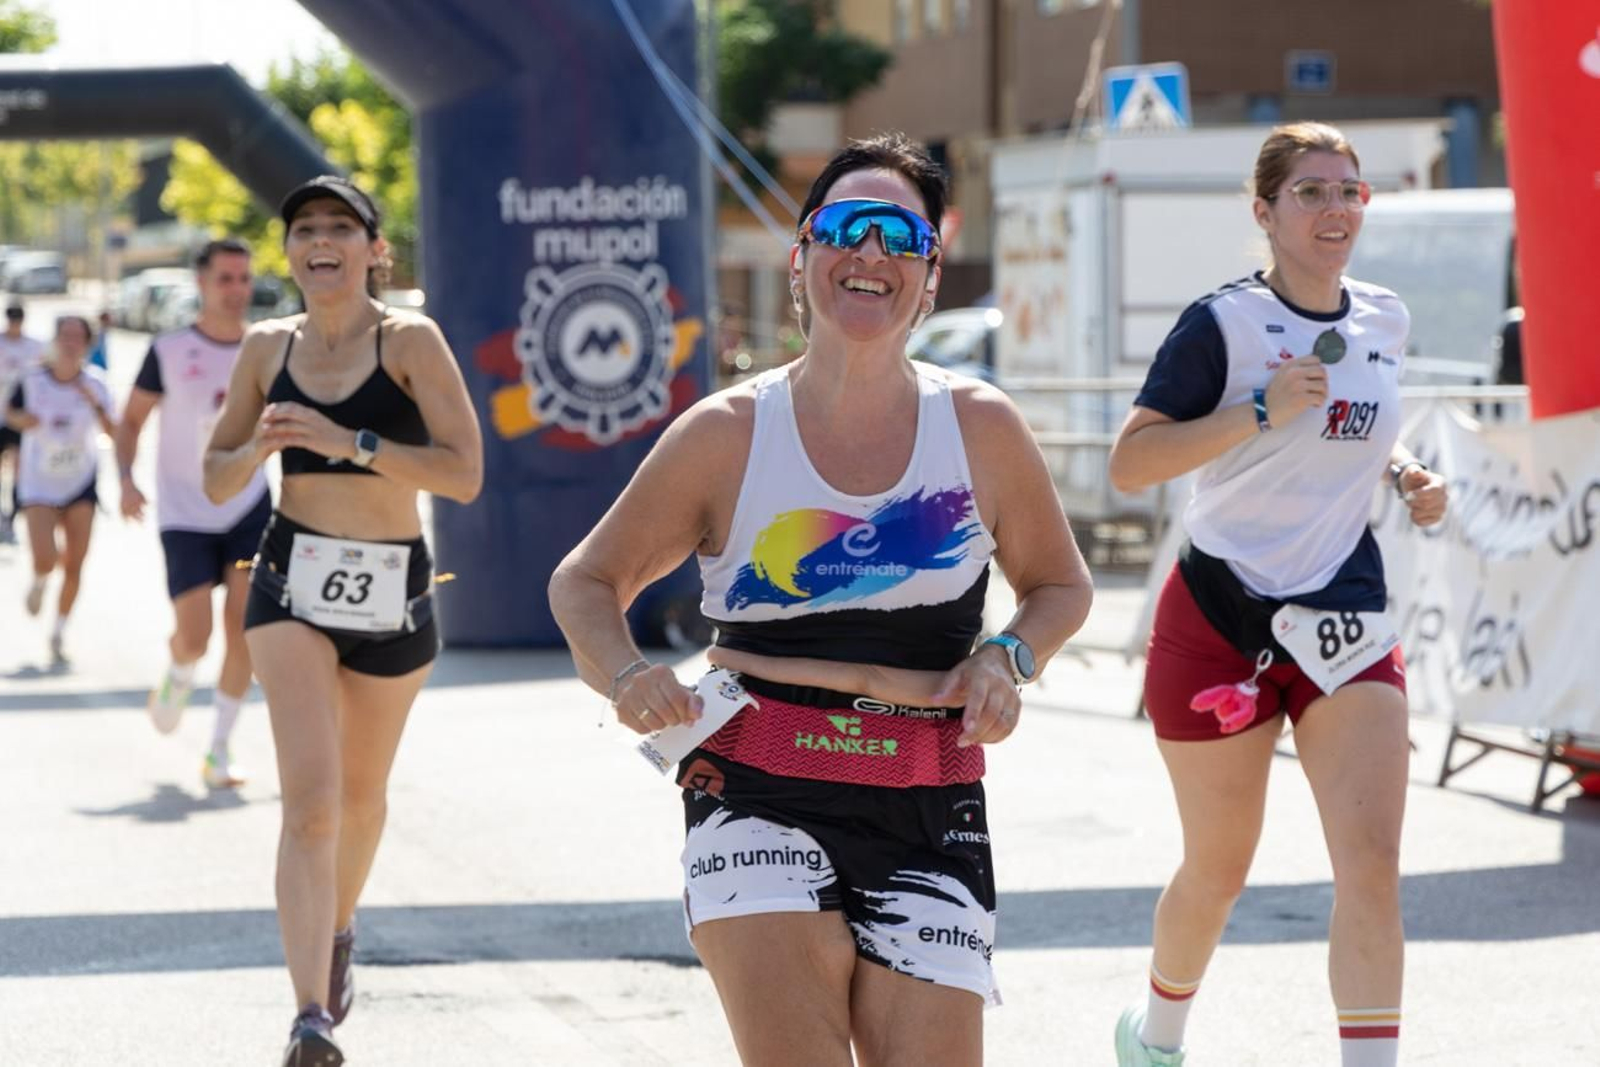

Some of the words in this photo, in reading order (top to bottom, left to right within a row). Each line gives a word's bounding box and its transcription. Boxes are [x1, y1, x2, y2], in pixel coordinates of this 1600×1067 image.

[499, 176, 687, 223] fundación
[534, 220, 658, 268] mupol
[816, 558, 907, 576] entrénate
[321, 569, 373, 605] 63
[1317, 611, 1364, 661] 88
[795, 731, 898, 756] HANKER
[690, 853, 726, 878] club
[732, 846, 821, 871] running
